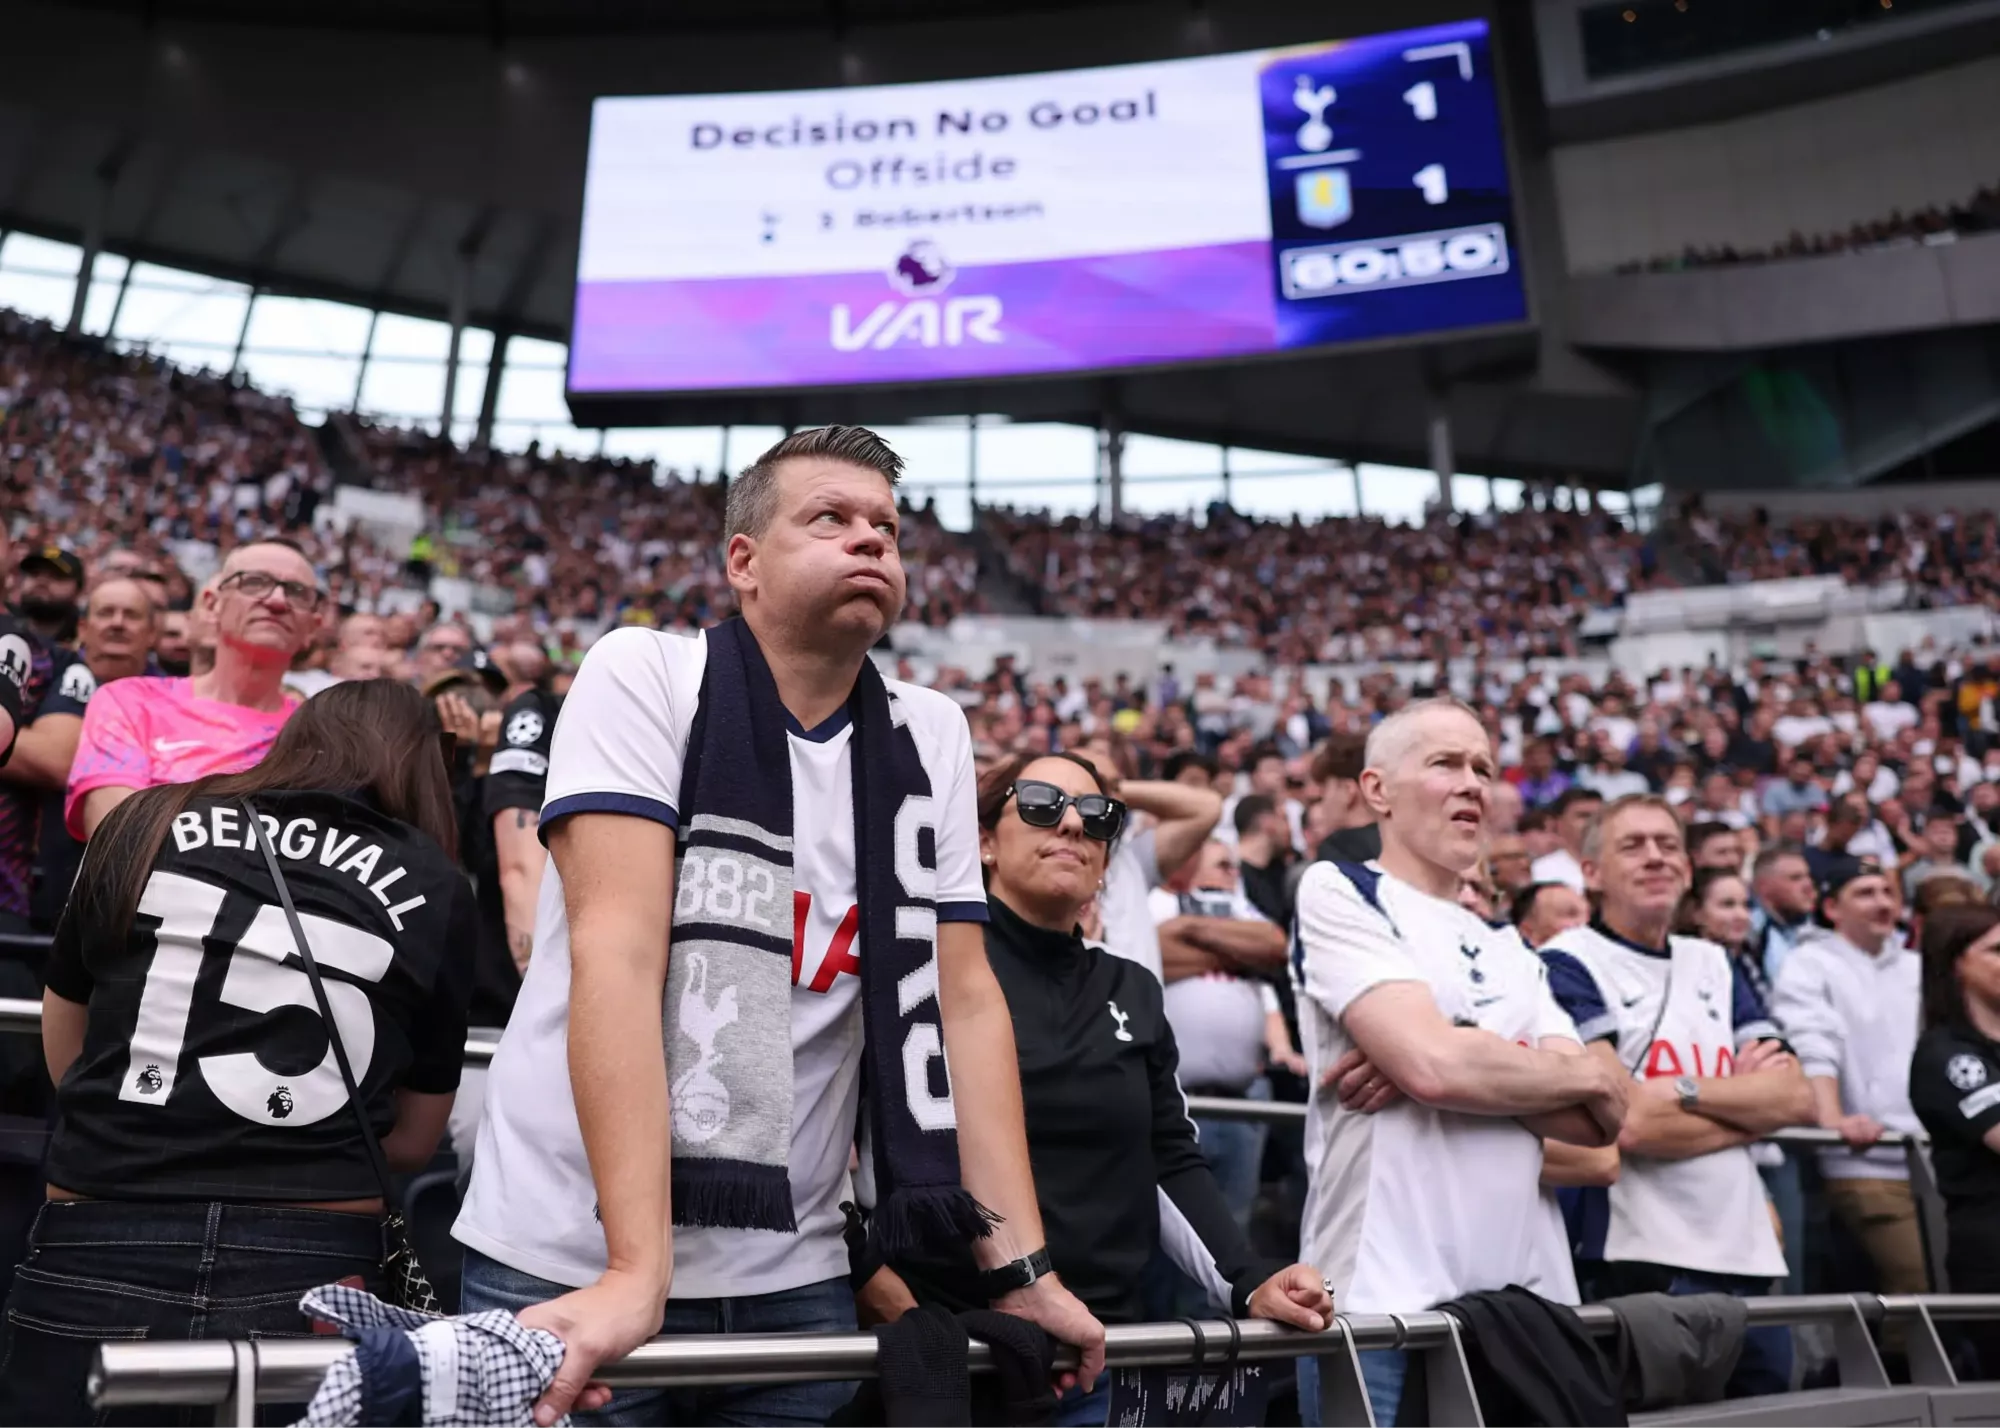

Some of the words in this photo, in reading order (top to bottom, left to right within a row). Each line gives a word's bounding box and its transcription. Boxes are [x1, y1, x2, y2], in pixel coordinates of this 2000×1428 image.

[690, 112, 916, 151] Decision
[937, 104, 1010, 136] No
[1029, 89, 1157, 131] Goal
[1403, 81, 1437, 121] 1
[826, 152, 1018, 190] Offside
[1412, 163, 1448, 205] 1
[830, 295, 1006, 351] VAR
[171, 806, 427, 932] BERGVALL
[672, 853, 776, 928] 882
[118, 870, 395, 1127] 15
